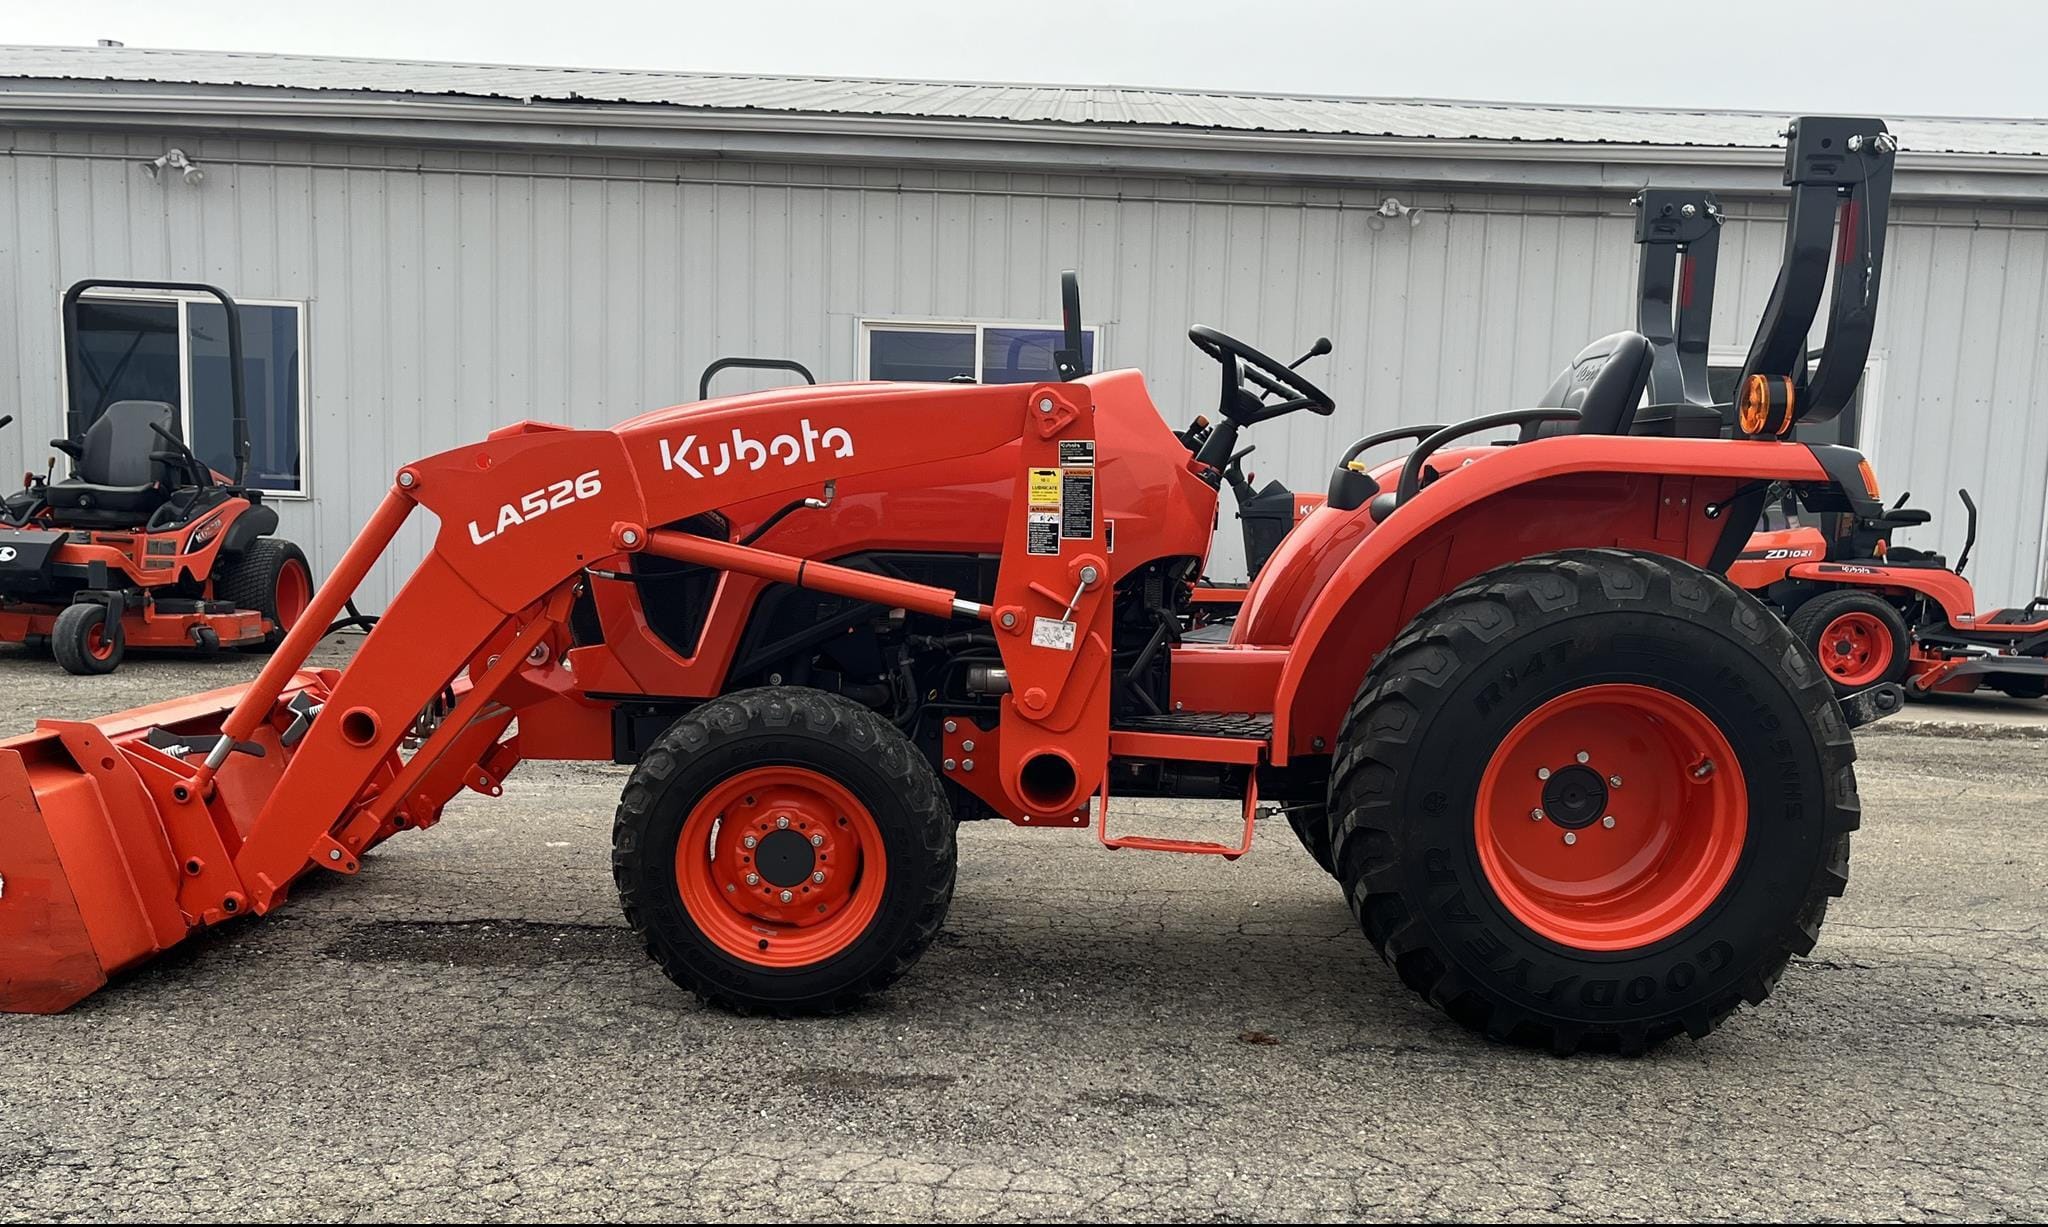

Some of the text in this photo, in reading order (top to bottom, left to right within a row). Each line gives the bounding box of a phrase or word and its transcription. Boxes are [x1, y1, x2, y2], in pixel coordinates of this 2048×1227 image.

[659, 419, 855, 479] Kubota
[468, 470, 602, 546] LA526
[1765, 549, 1813, 559] ZD1021
[1423, 846, 1736, 1010] GOODYEAR
